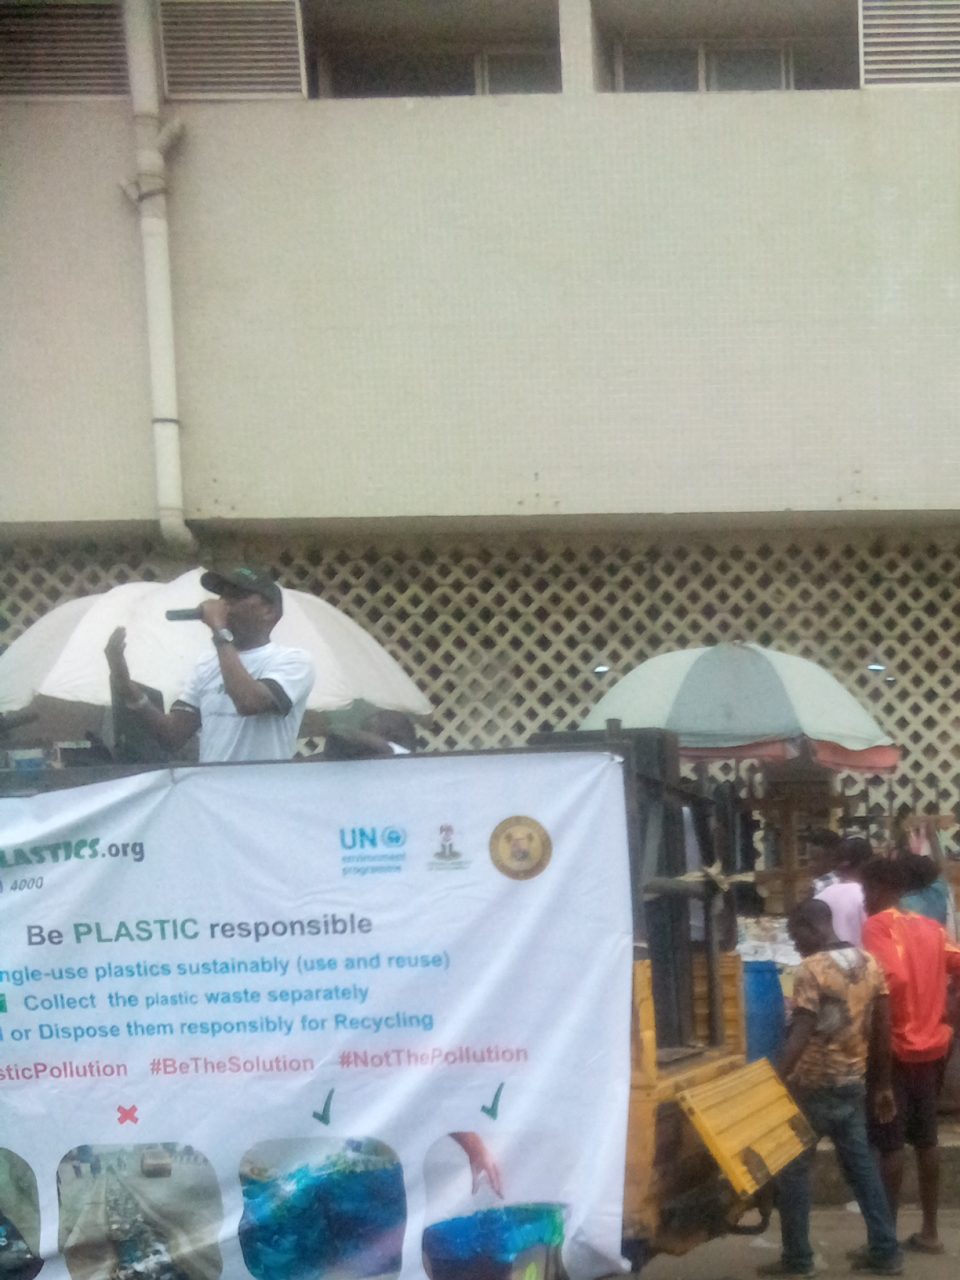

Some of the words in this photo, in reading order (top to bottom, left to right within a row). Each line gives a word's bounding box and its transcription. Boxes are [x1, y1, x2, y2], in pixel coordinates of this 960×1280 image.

[339, 827, 377, 849] UN
[27, 925, 63, 946] Be
[73, 918, 200, 943] PLASTIC
[210, 913, 373, 942] responsible
[95, 960, 171, 982] plastics
[177, 955, 289, 976] sustainably
[297, 955, 337, 975] (use
[345, 953, 380, 970] and
[388, 951, 450, 970] reuse)
[24, 994, 96, 1011] Collect
[108, 991, 139, 1008] the
[145, 991, 199, 1009] plastic
[205, 988, 261, 1004] waste
[267, 984, 369, 1004] separately
[11, 1028, 32, 1041] or
[39, 1023, 120, 1042] Dispose
[126, 1021, 174, 1037] them
[180, 1015, 294, 1037] responsibly
[301, 1015, 327, 1031] for
[334, 1012, 434, 1033] Recycling
[150, 1055, 315, 1076] #BeTheSolution
[340, 1045, 529, 1068] #NotThePollution
